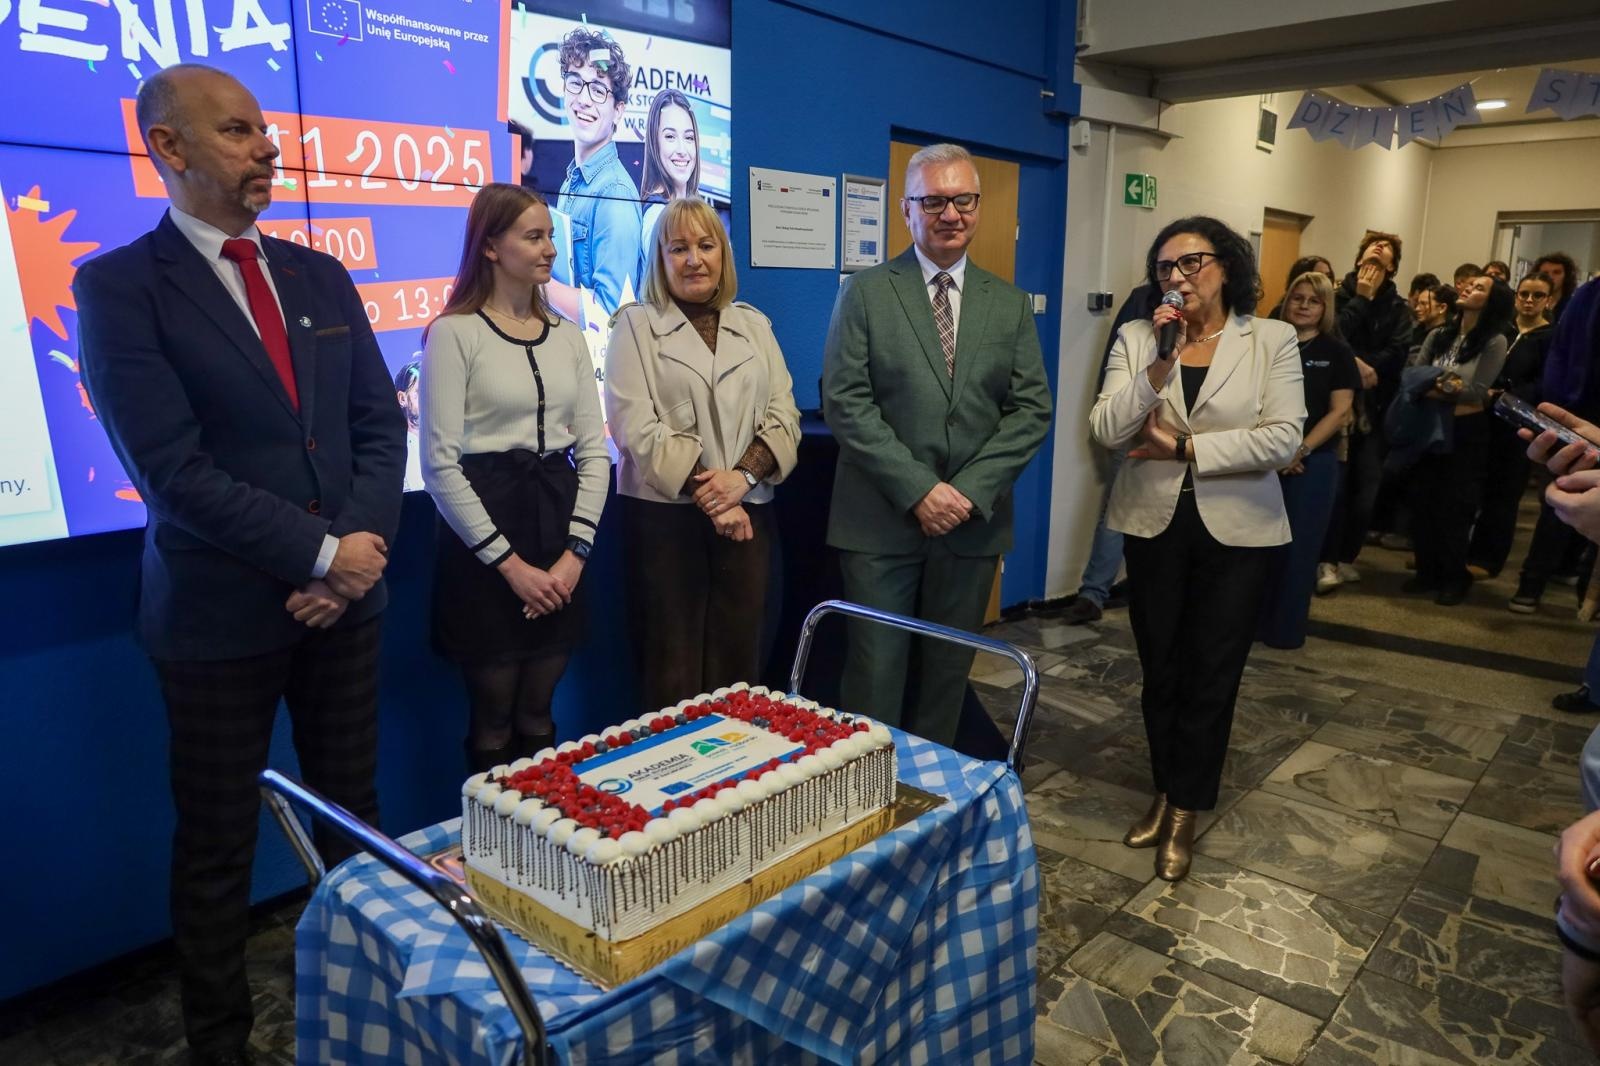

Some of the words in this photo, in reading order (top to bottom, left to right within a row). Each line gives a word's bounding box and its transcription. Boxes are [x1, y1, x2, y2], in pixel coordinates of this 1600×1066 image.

[0, 0, 291, 69] ENIA
[365, 7, 461, 37] Współfinansowane
[464, 30, 489, 43] przez
[366, 23, 391, 40] Unię
[394, 29, 451, 51] Europejską
[634, 66, 711, 96] ADEMIA
[266, 123, 485, 193] 11.2025
[0, 479, 31, 496] ny.
[627, 753, 690, 780] AKADEMIA
